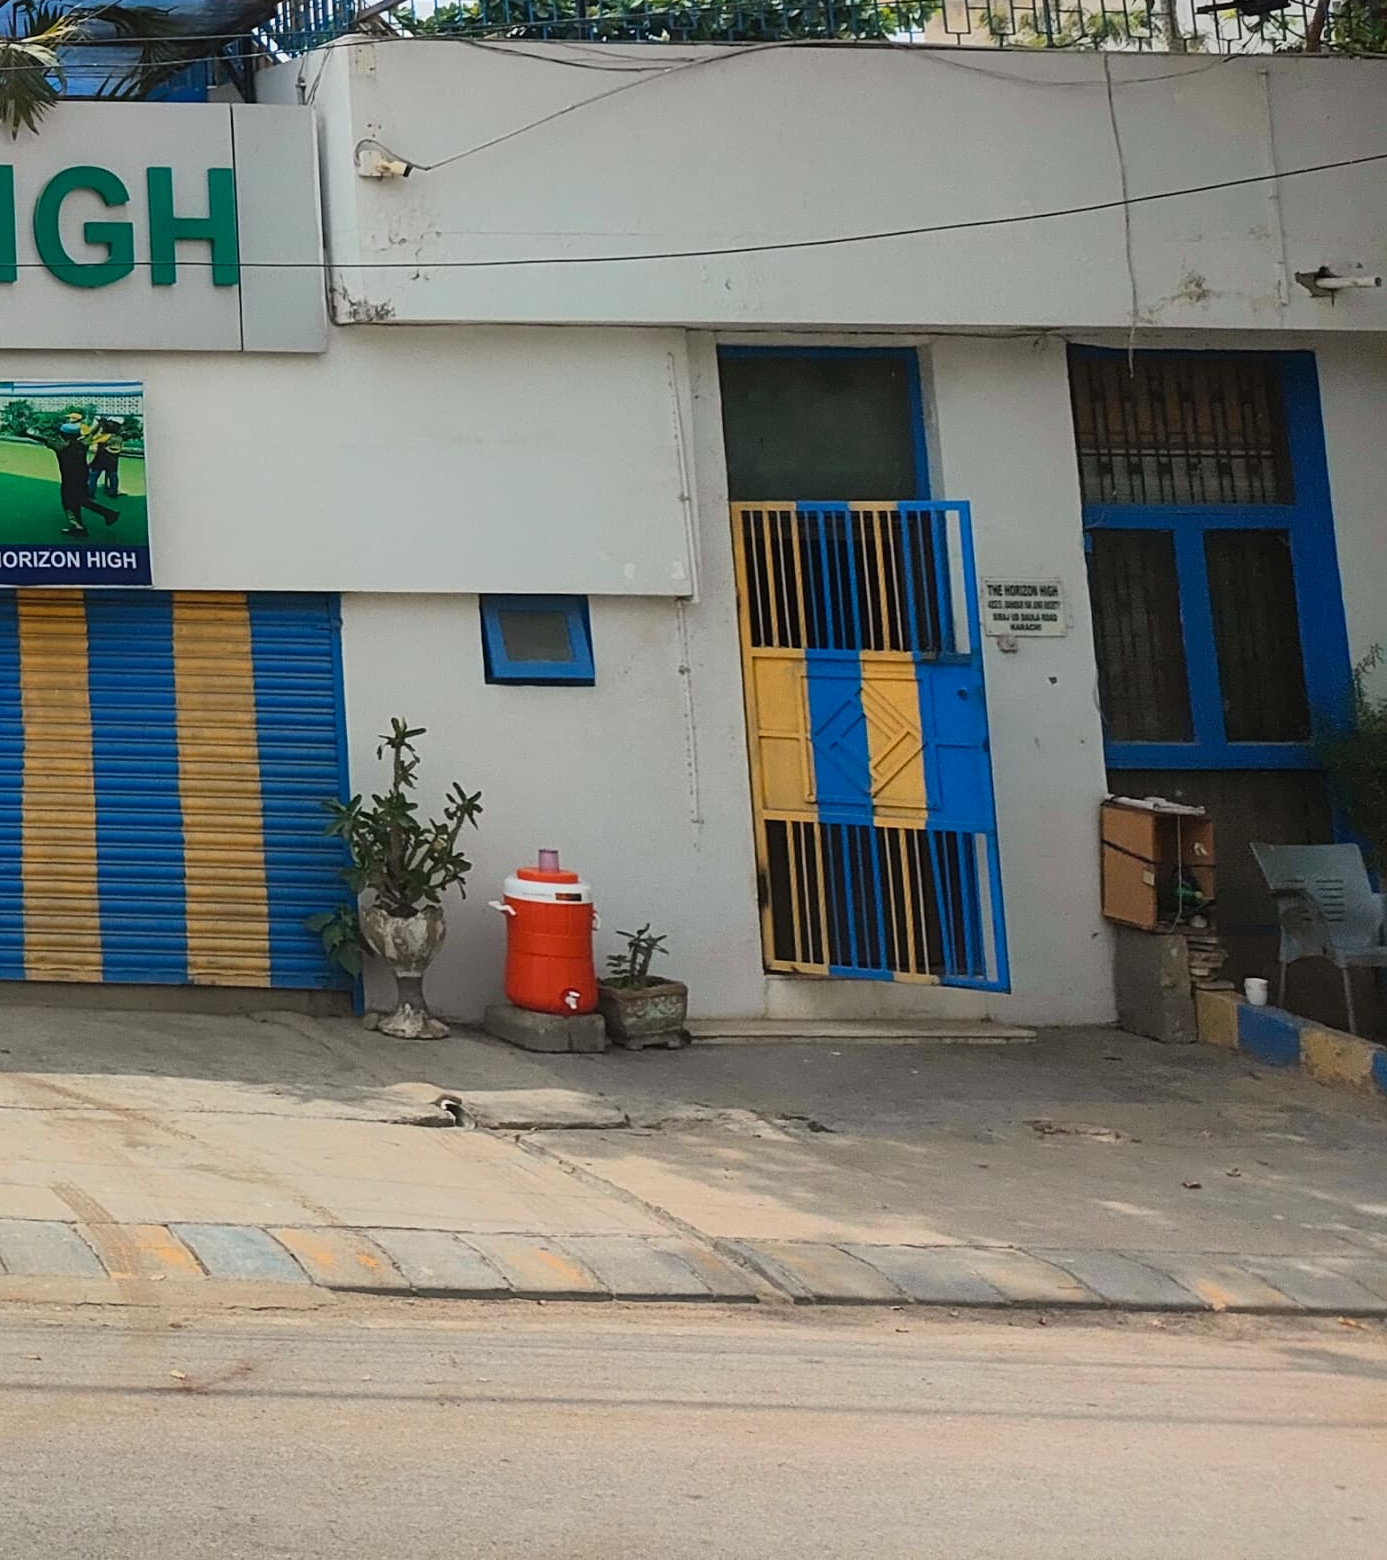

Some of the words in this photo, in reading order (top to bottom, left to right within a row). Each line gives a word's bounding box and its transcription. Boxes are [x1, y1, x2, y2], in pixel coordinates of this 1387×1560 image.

[86, 551, 137, 569] HIGH
[987, 584, 1003, 597] THE
[1004, 584, 1038, 597] HORIZON
[1039, 584, 1059, 597] HIGH
